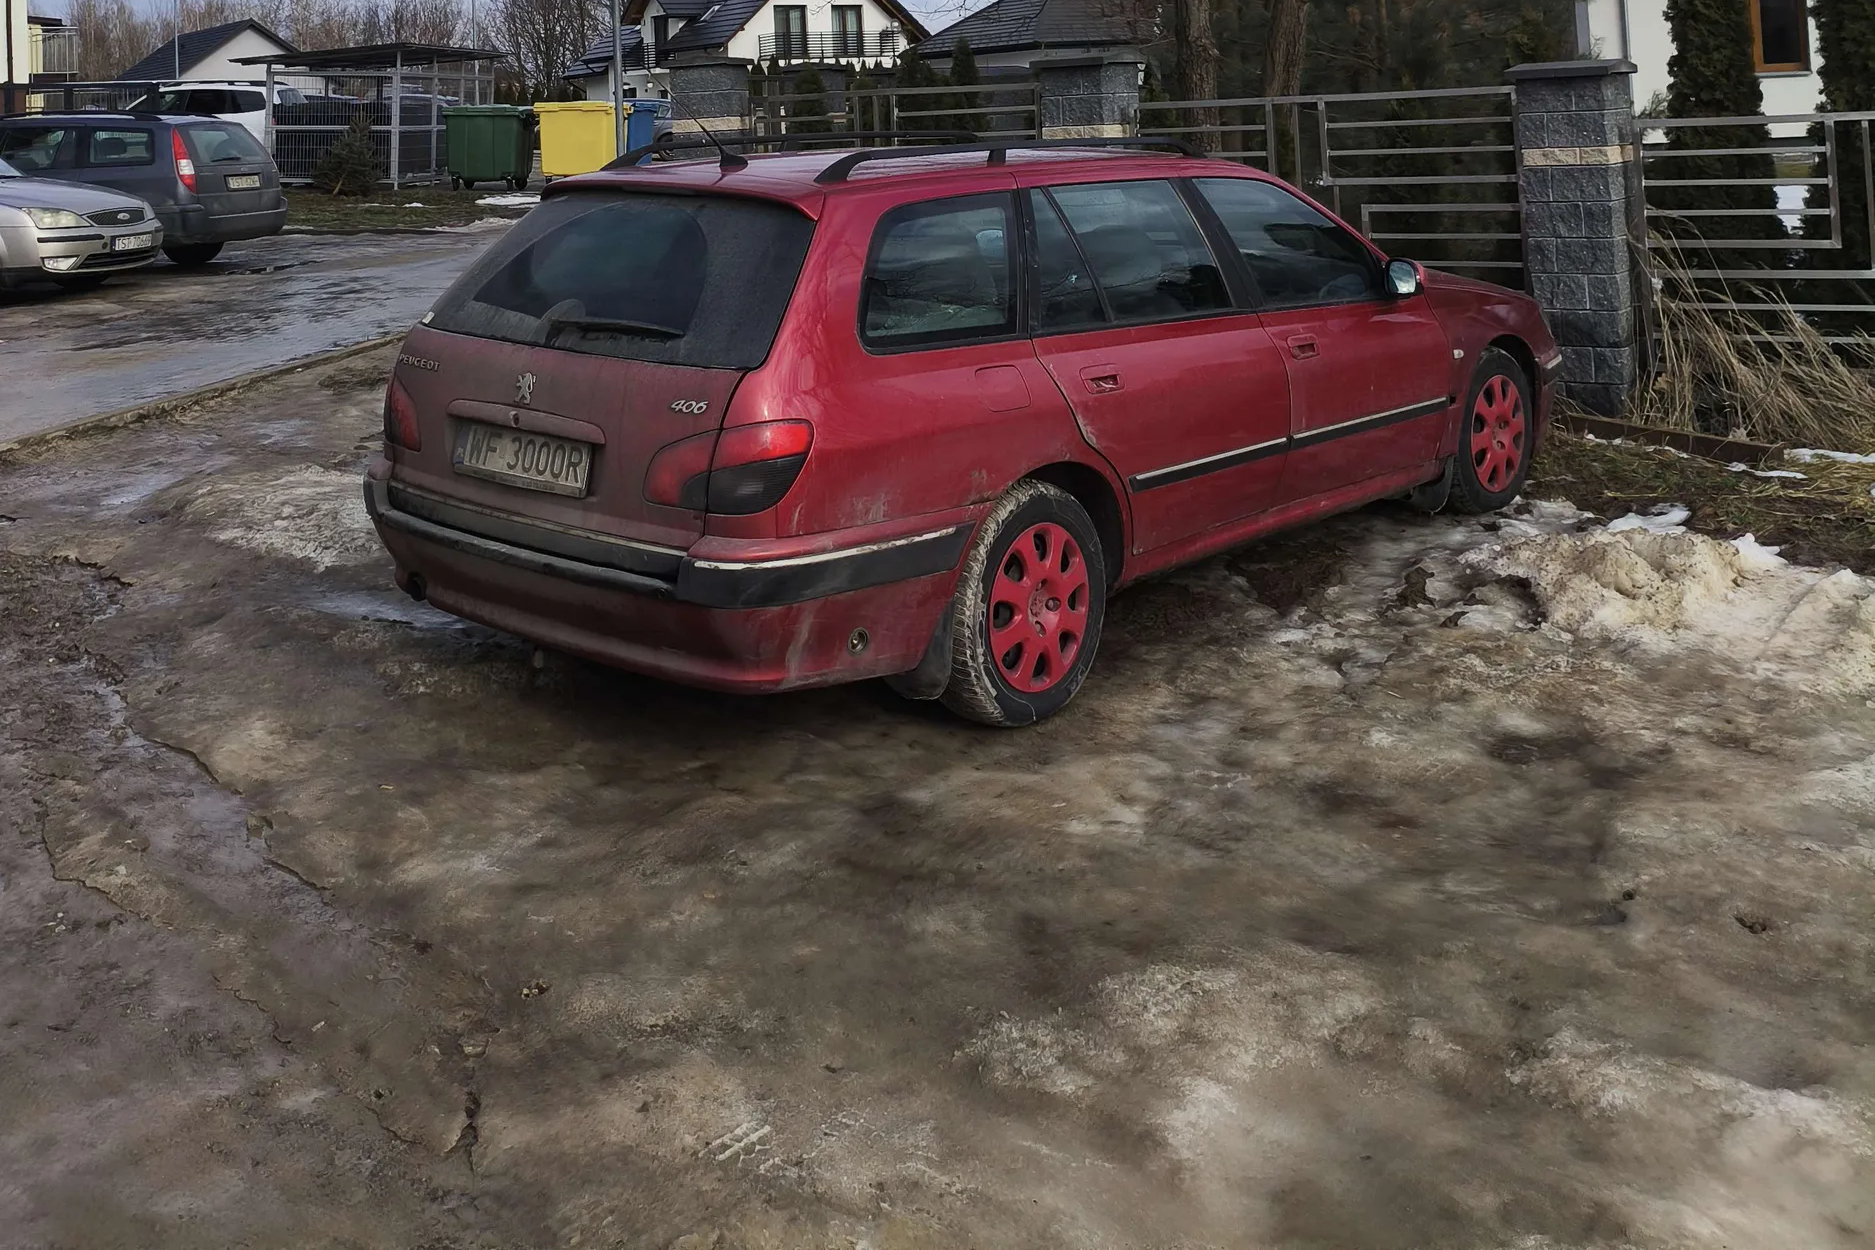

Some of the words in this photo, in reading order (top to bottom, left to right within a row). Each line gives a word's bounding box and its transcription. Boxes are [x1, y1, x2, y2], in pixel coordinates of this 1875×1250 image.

[116, 237, 131, 250] TST
[399, 353, 441, 371] PEUGEOT
[670, 399, 709, 414] 406
[467, 426, 503, 466] WF
[506, 435, 584, 484] 3000R
